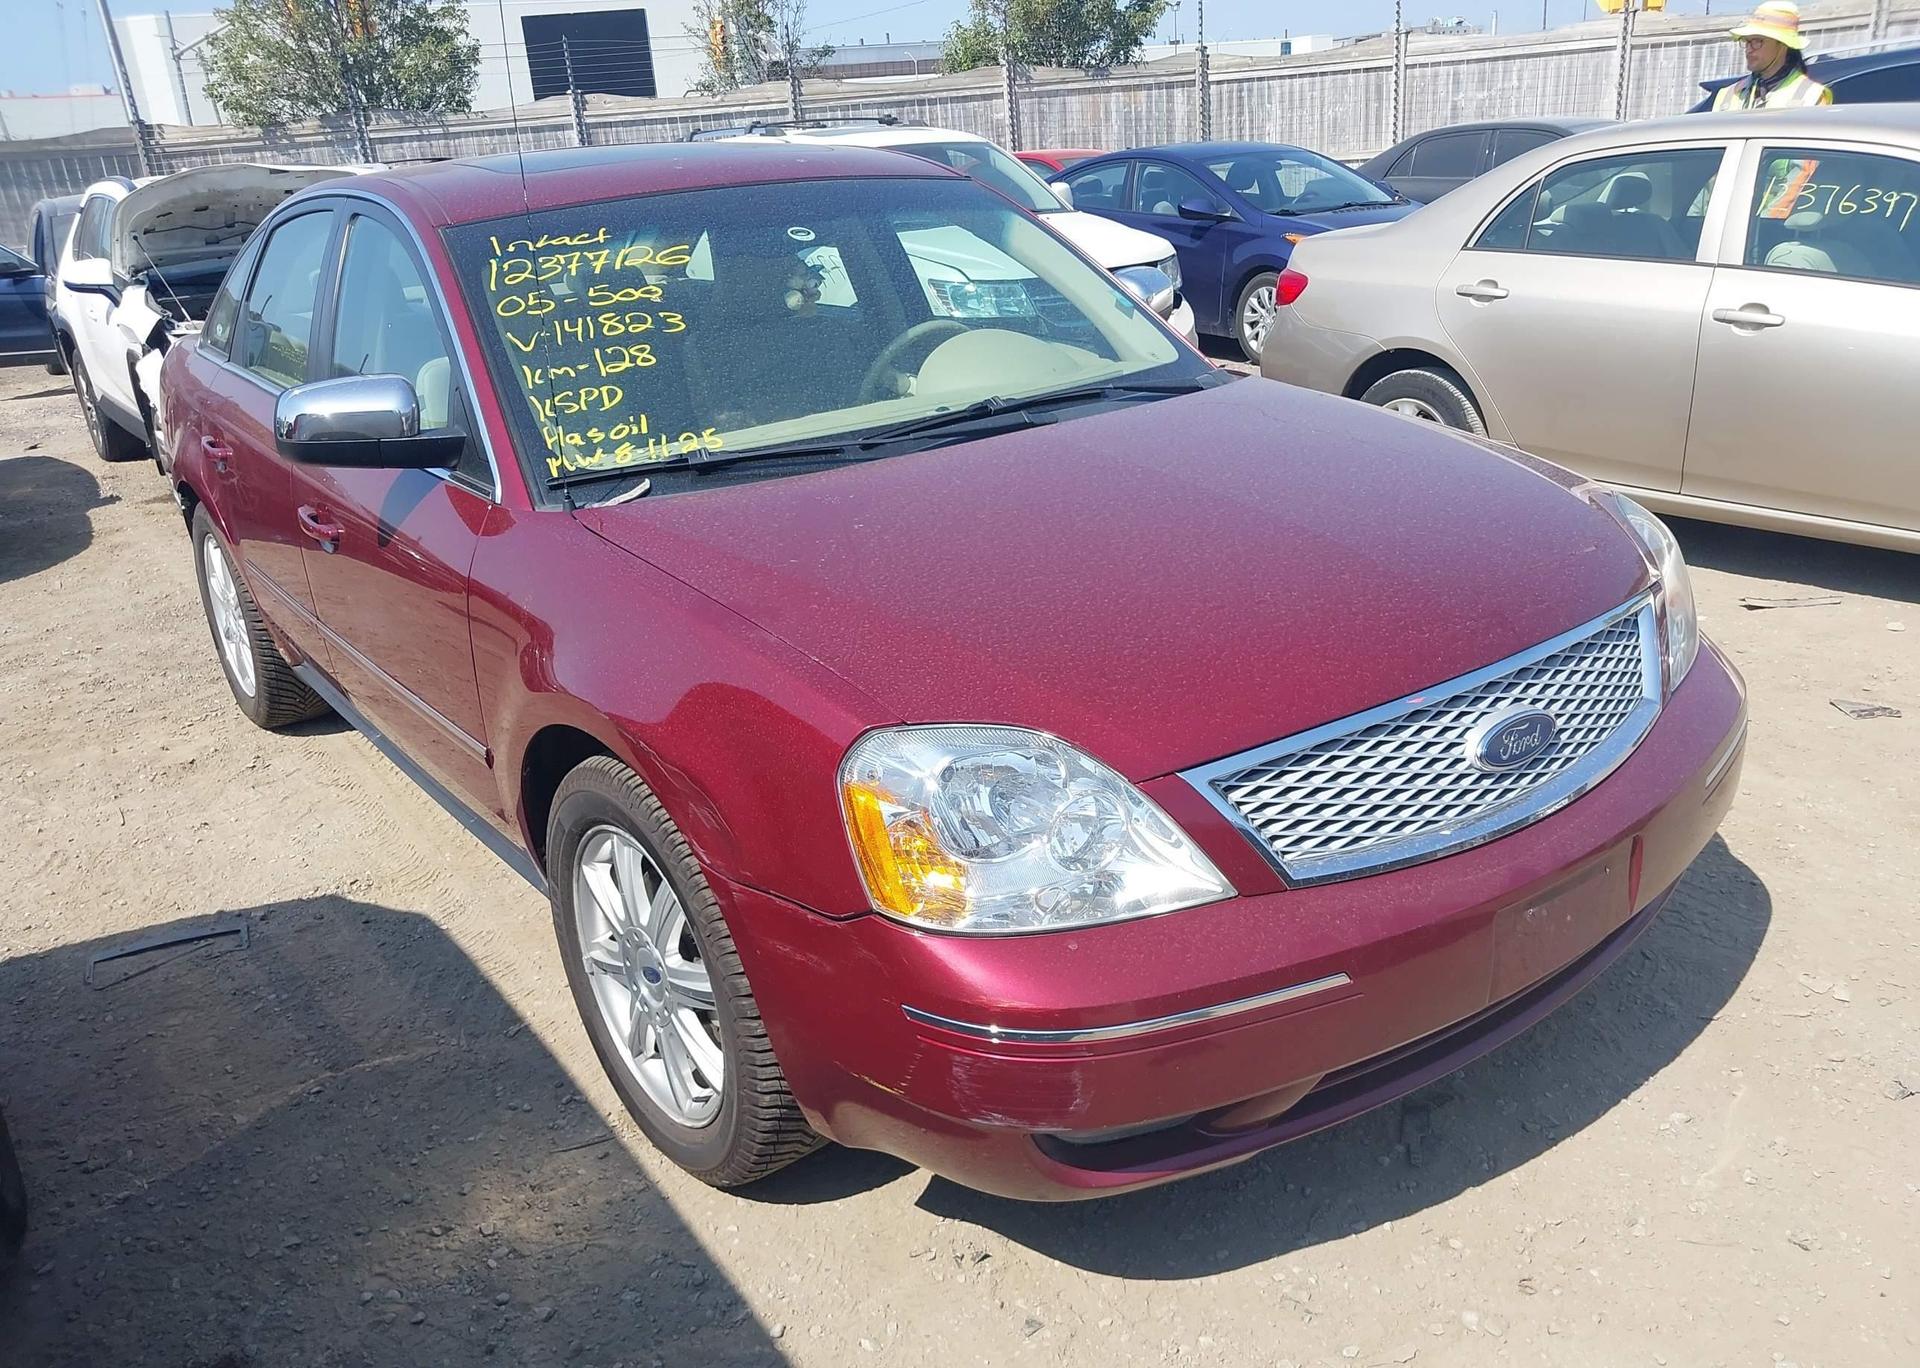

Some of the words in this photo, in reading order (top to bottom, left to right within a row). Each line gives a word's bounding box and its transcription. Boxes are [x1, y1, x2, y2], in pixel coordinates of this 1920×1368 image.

[1756, 176, 1918, 232] 12376397
[489, 245, 690, 291] 12377126
[1500, 722, 1541, 760] Ford
